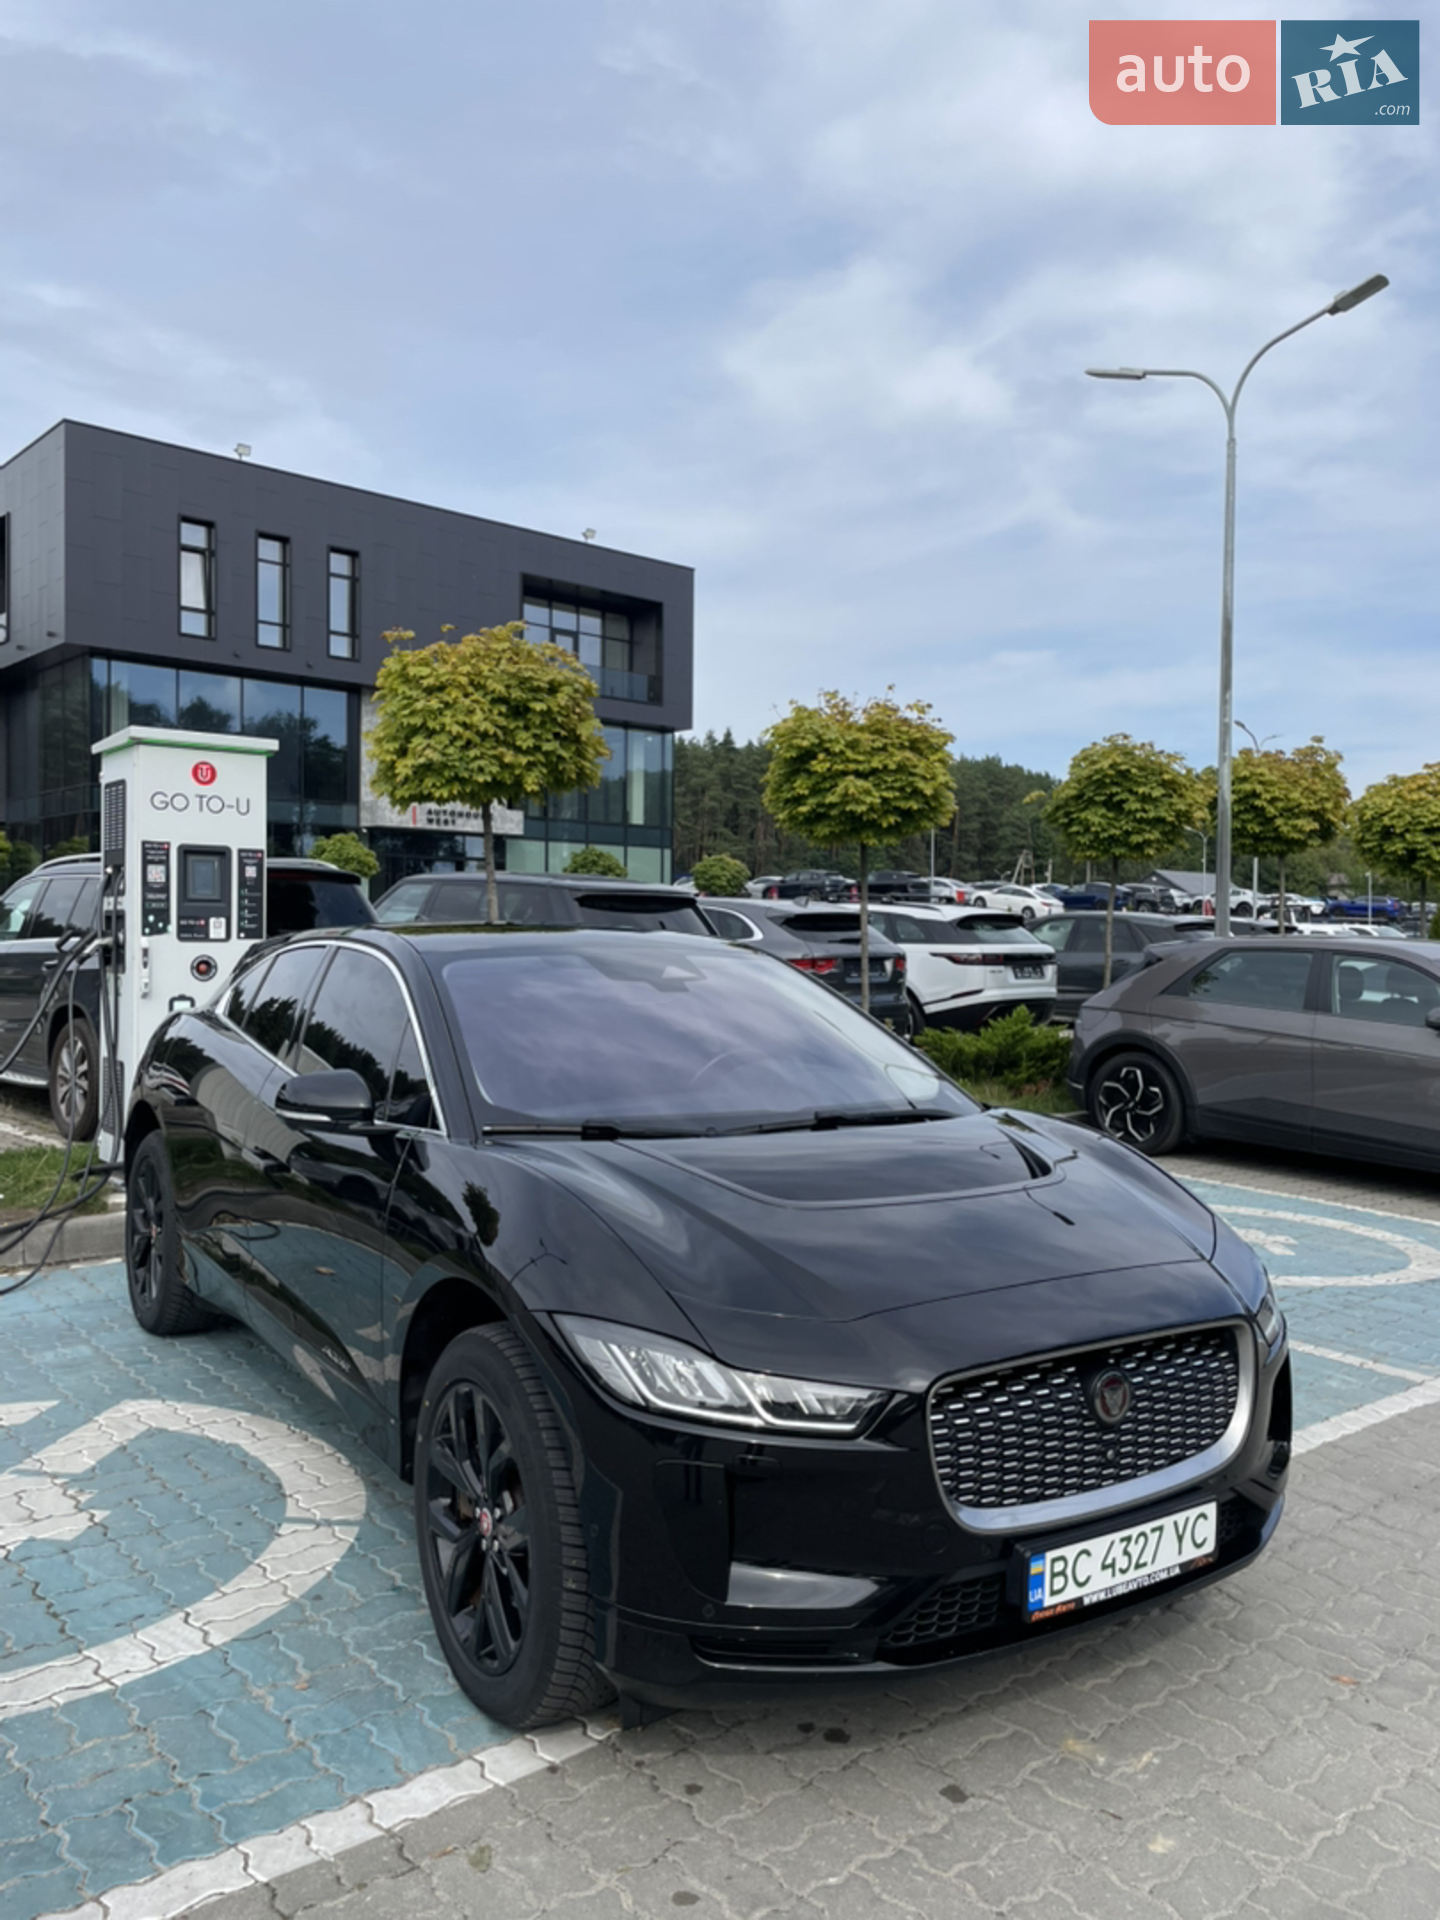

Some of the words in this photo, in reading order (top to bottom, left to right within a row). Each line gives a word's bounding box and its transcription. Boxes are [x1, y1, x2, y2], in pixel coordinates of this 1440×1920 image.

[150, 791, 190, 812] GO
[195, 794, 251, 816] TO-U
[427, 808, 484, 820] AUTOHOU
[1049, 1549, 1093, 1598] BC
[1101, 1525, 1165, 1579] 4327
[1173, 1512, 1209, 1556] YC
